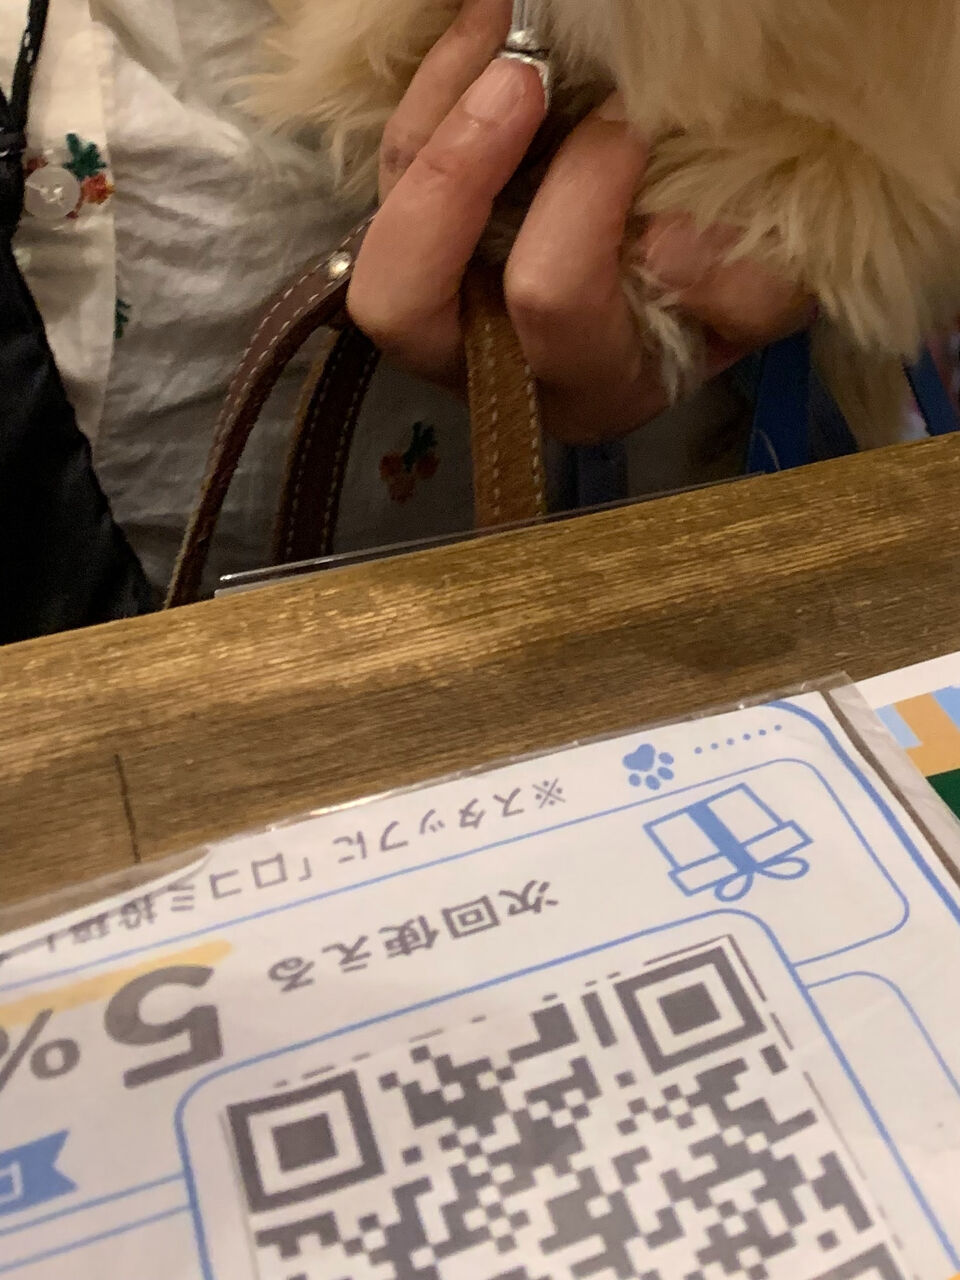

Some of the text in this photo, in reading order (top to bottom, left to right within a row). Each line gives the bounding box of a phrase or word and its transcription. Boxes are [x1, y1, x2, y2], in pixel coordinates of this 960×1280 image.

[268, 879, 560, 994] 次回使える
